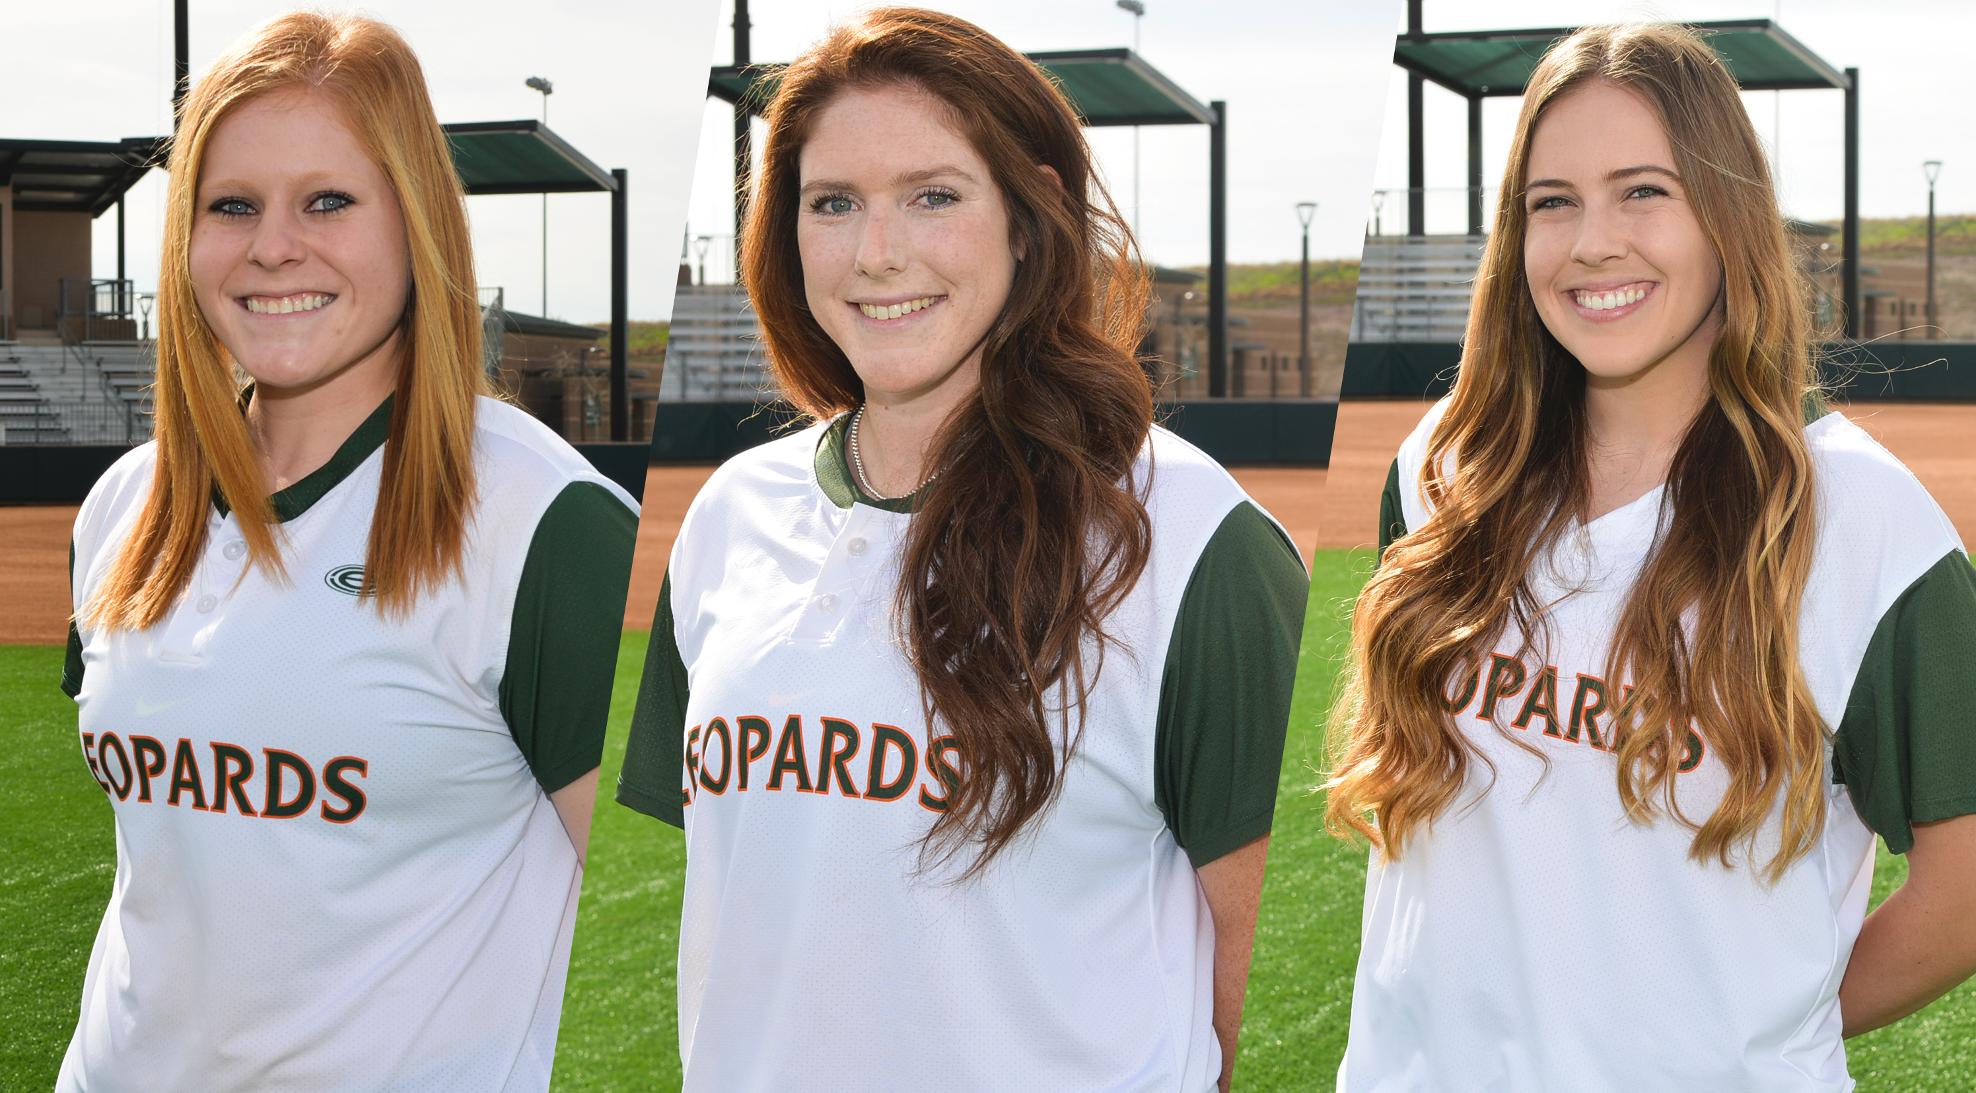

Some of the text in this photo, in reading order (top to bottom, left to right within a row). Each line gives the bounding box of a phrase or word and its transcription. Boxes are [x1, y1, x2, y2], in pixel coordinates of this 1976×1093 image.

[1441, 649, 1706, 774] OPAR
[81, 730, 368, 825] EOPARDS
[681, 714, 962, 814] EOPARDS
